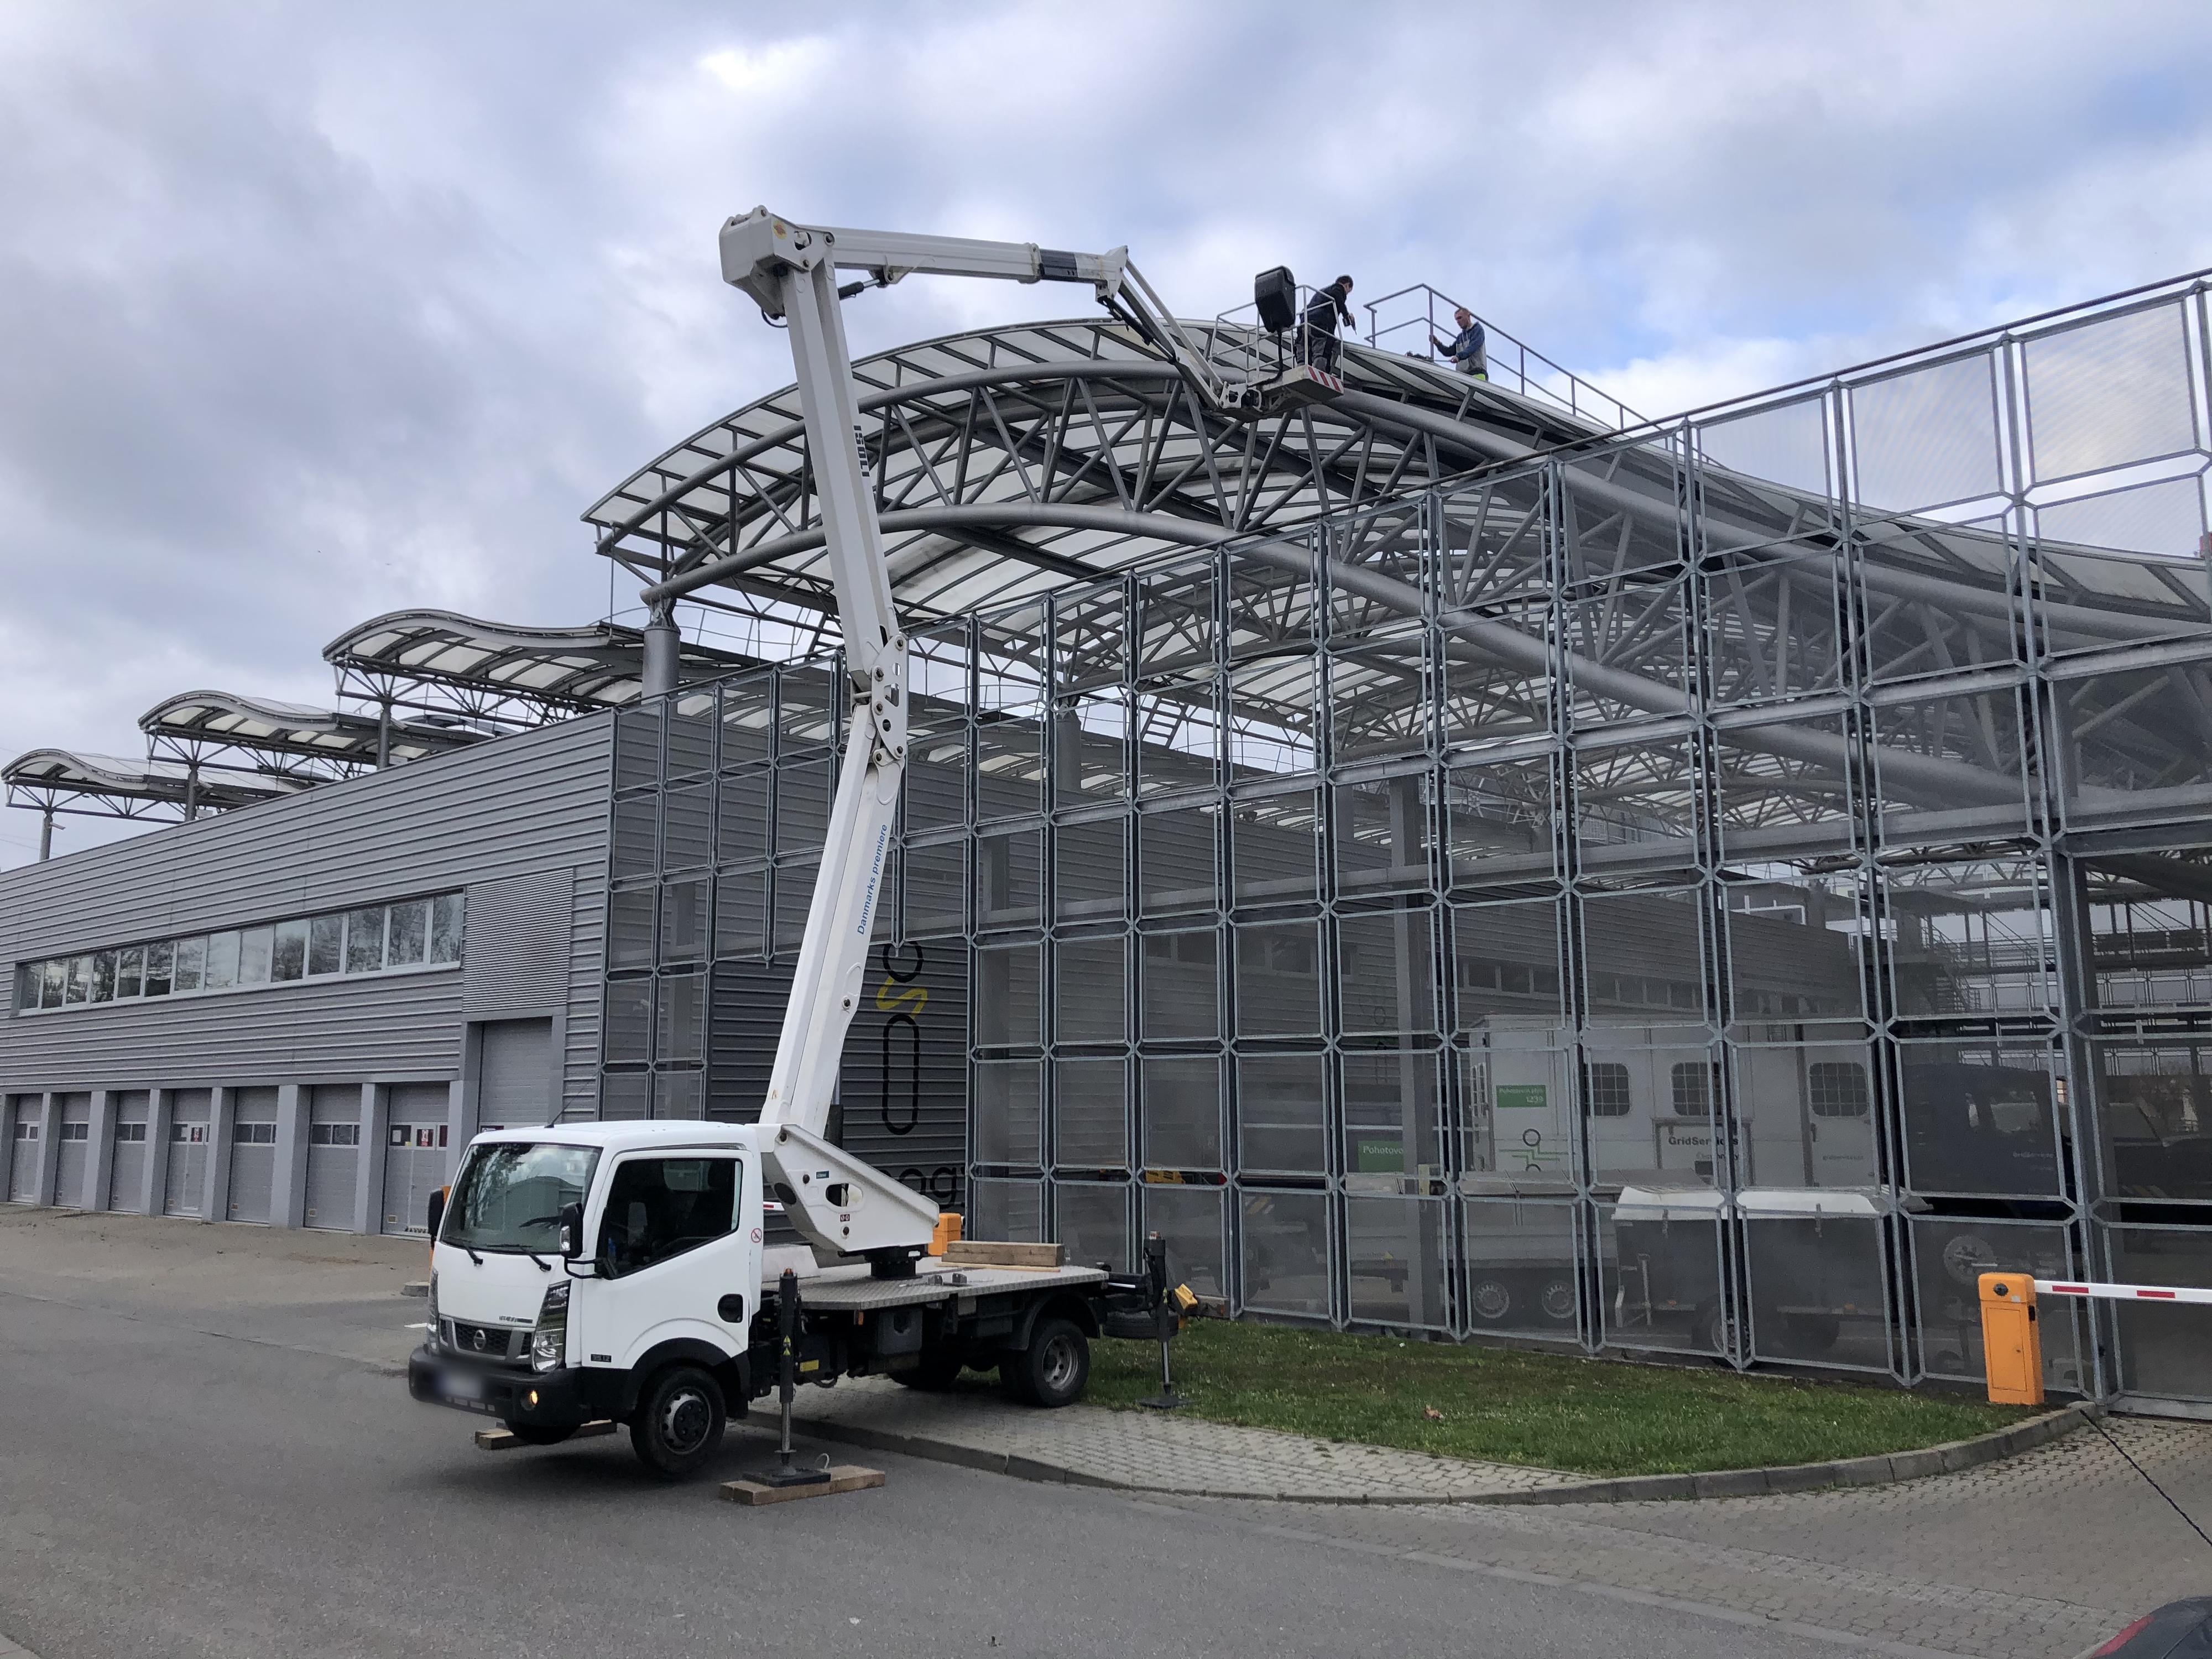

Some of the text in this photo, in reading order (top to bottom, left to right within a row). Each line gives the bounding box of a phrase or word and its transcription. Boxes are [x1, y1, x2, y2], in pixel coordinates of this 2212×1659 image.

[853, 425, 870, 477] ISOLI
[857, 824, 888, 935] Danmarks premiere
[1668, 1136, 1739, 1146] GridSerics
